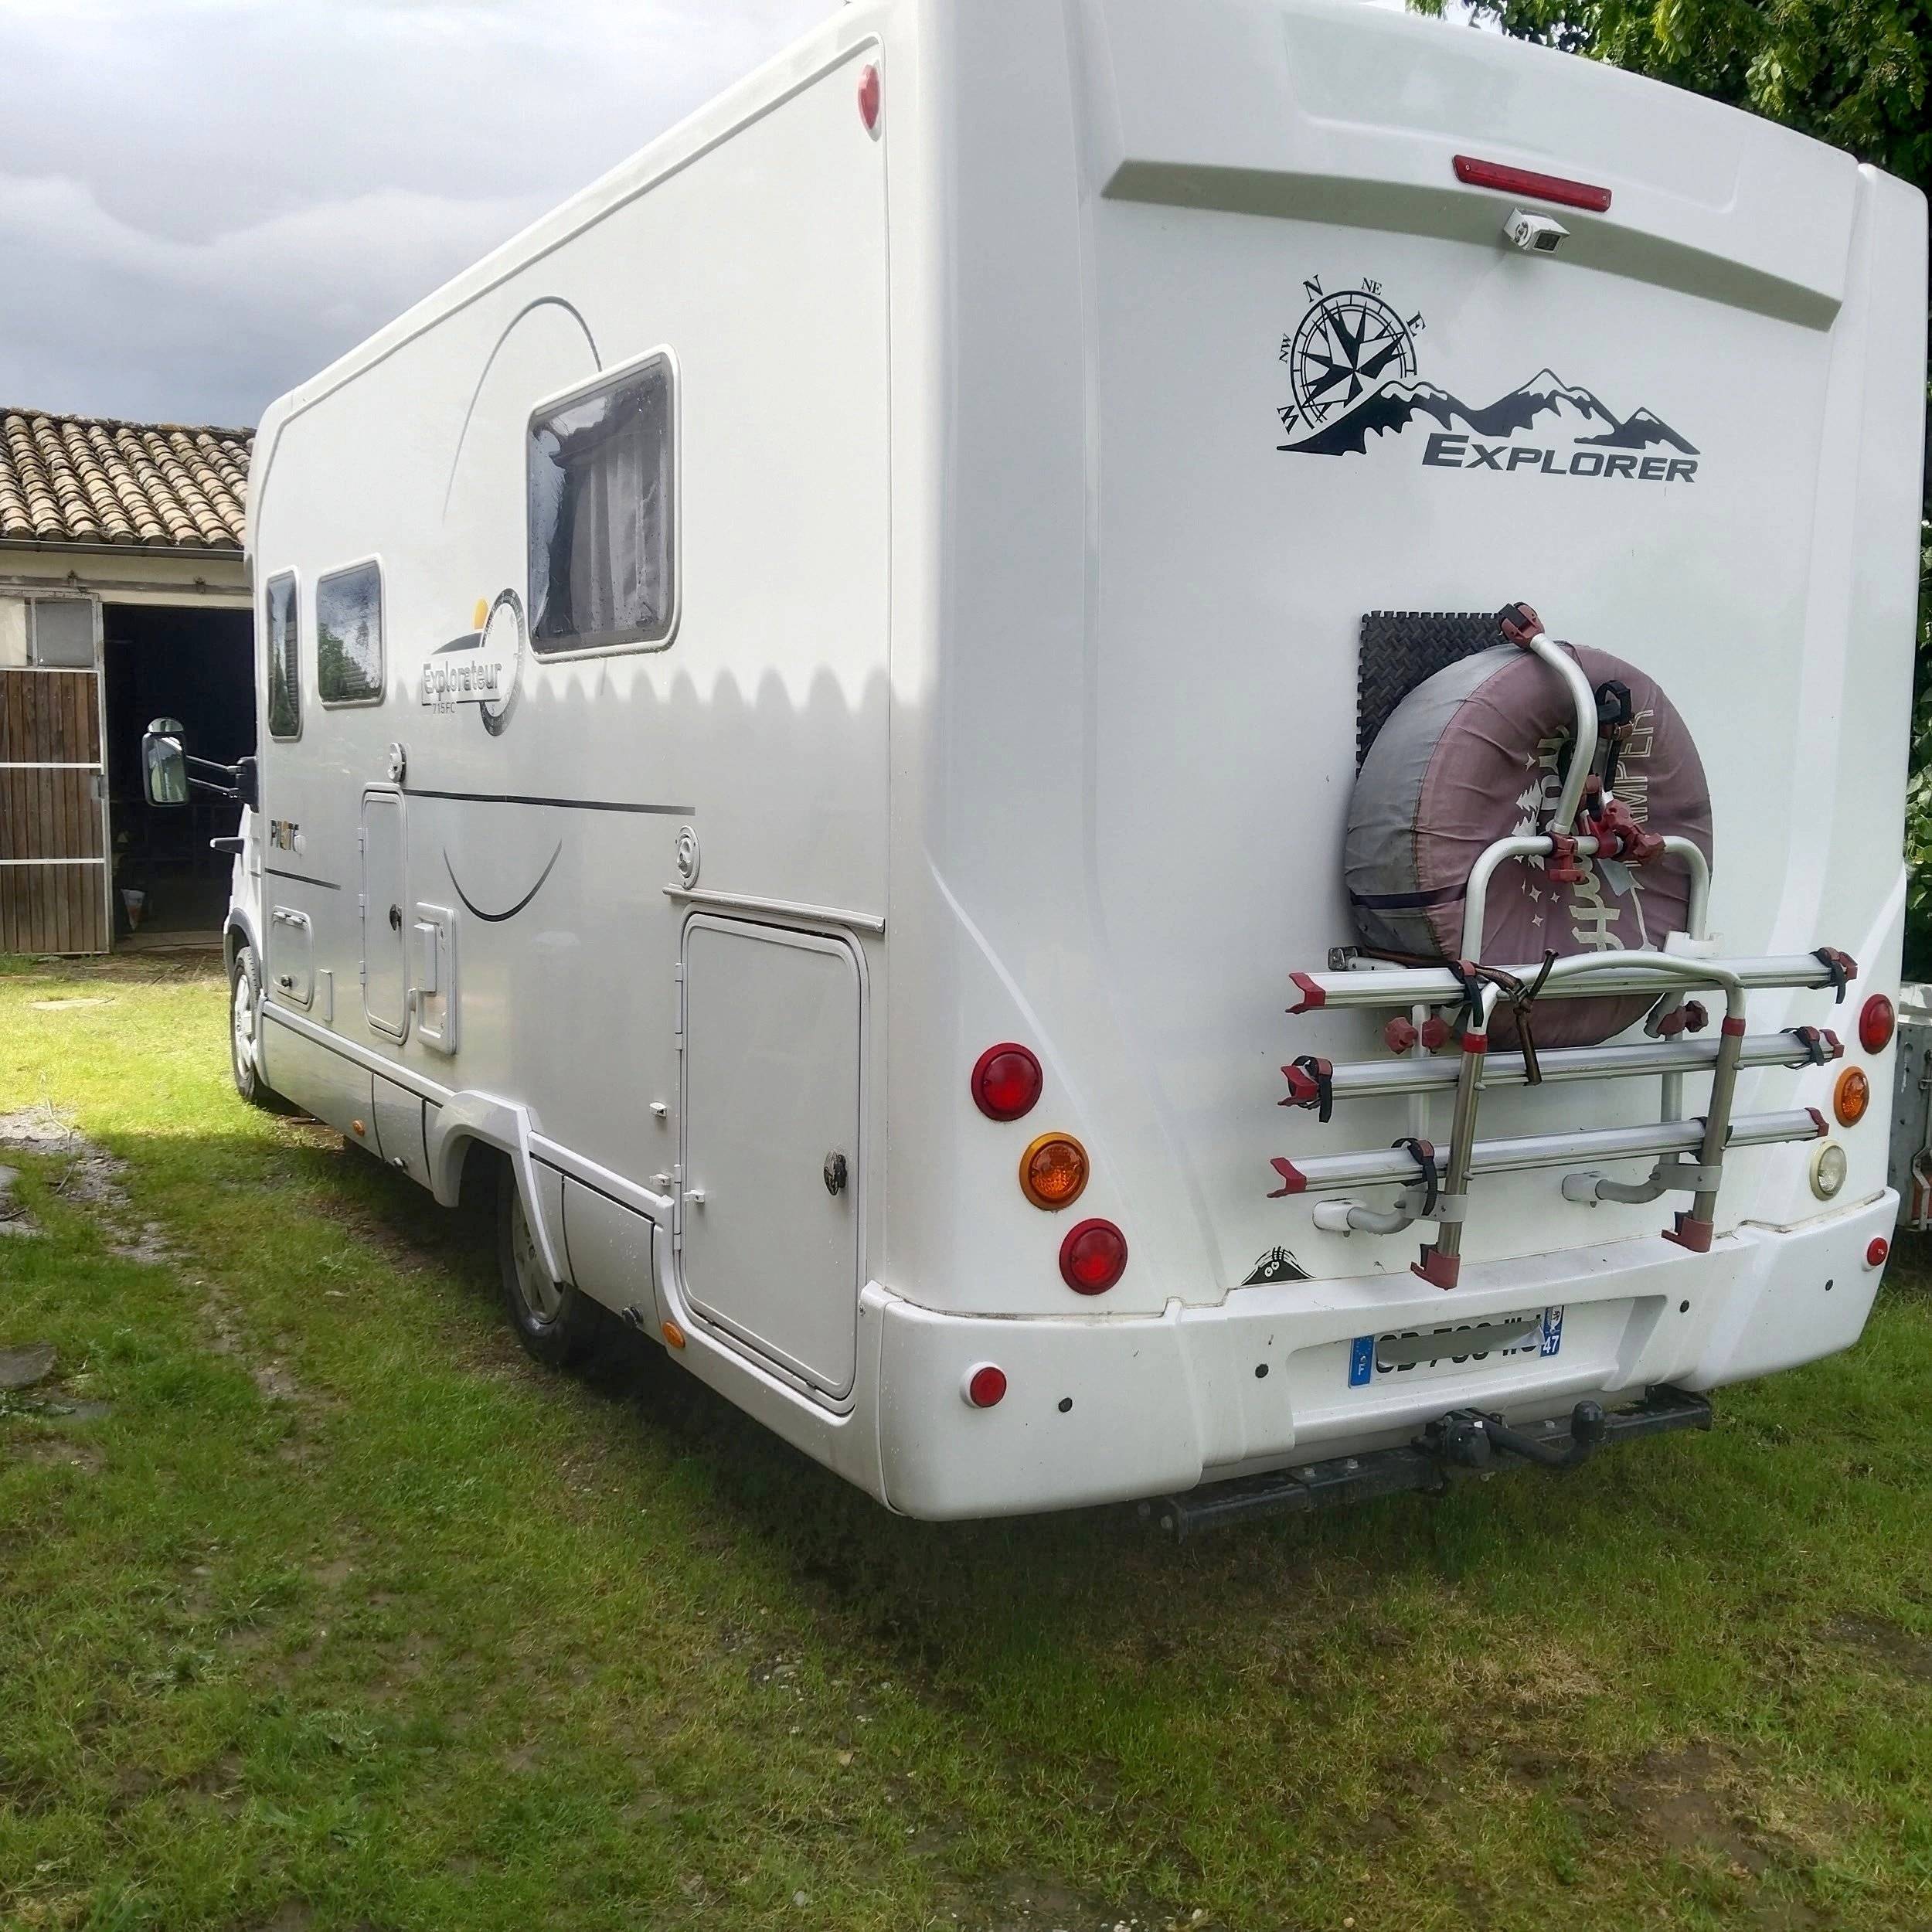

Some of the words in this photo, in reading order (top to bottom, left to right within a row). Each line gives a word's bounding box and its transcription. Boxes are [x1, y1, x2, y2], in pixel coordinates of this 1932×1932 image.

[1302, 274, 1323, 303] N
[1361, 277, 1383, 295] NE
[1406, 311, 1427, 337] E
[1278, 333, 1291, 363] NW
[1422, 432, 1699, 483] EXPLORER
[423, 660, 502, 701] Explorateur
[1543, 1335, 1560, 1354] 47
[1358, 1364, 1366, 1376] F
